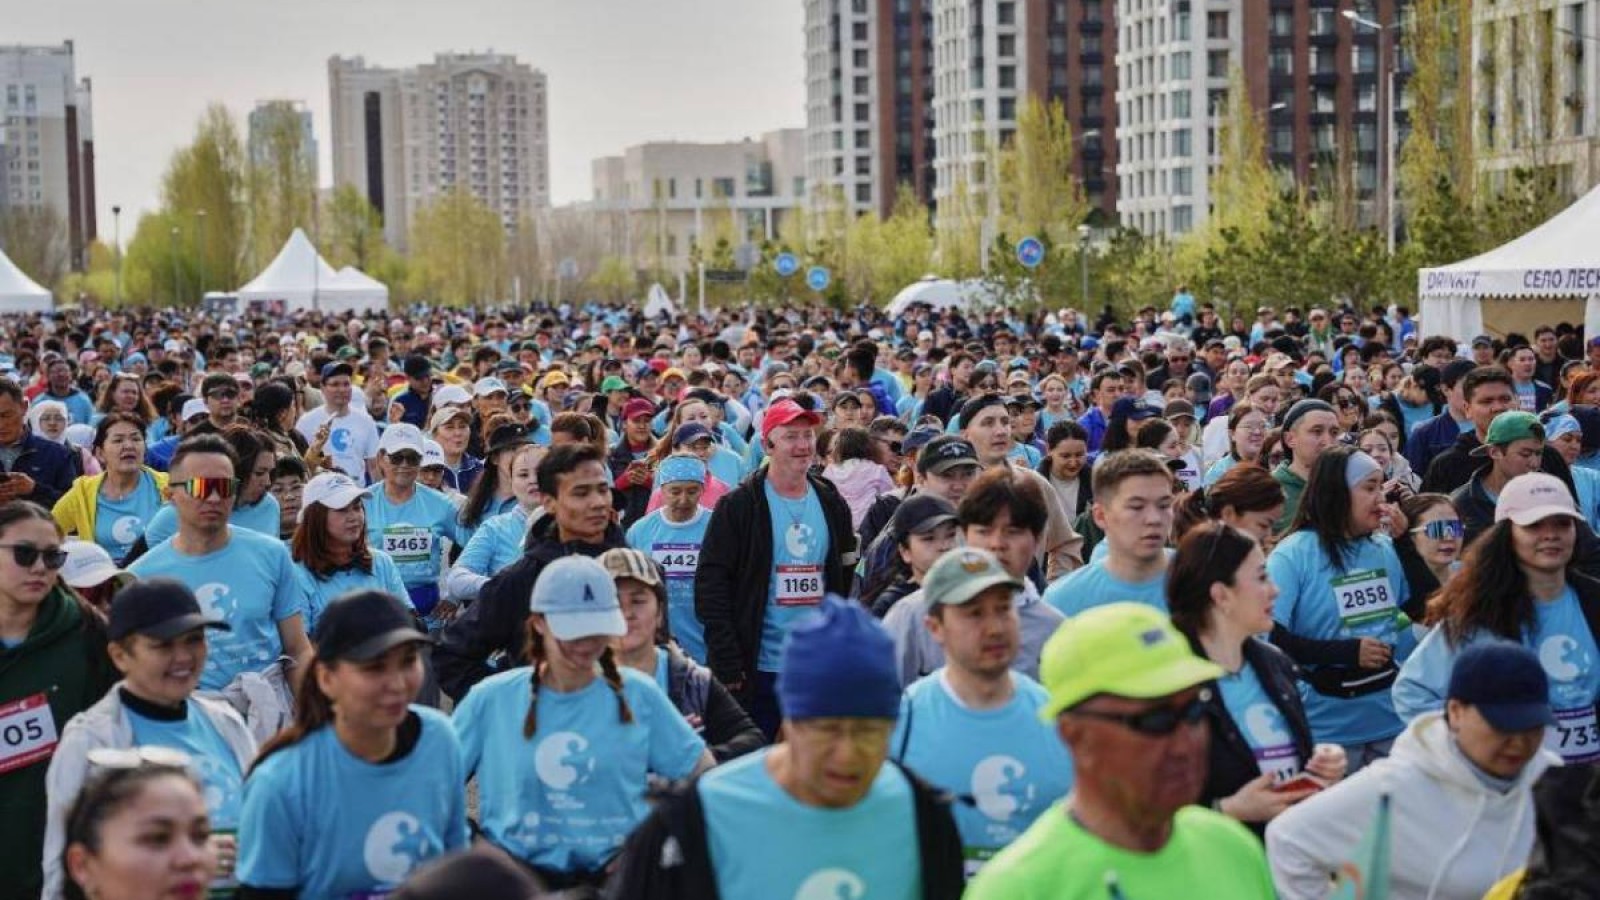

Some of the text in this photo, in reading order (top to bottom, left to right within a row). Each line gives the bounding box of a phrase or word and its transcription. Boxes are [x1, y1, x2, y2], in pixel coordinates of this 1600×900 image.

[1524, 269, 1562, 288] СЕЛО
[387, 537, 428, 551] 3463
[662, 554, 696, 567] 442
[784, 578, 818, 592] 1168
[1343, 585, 1388, 609] 2858
